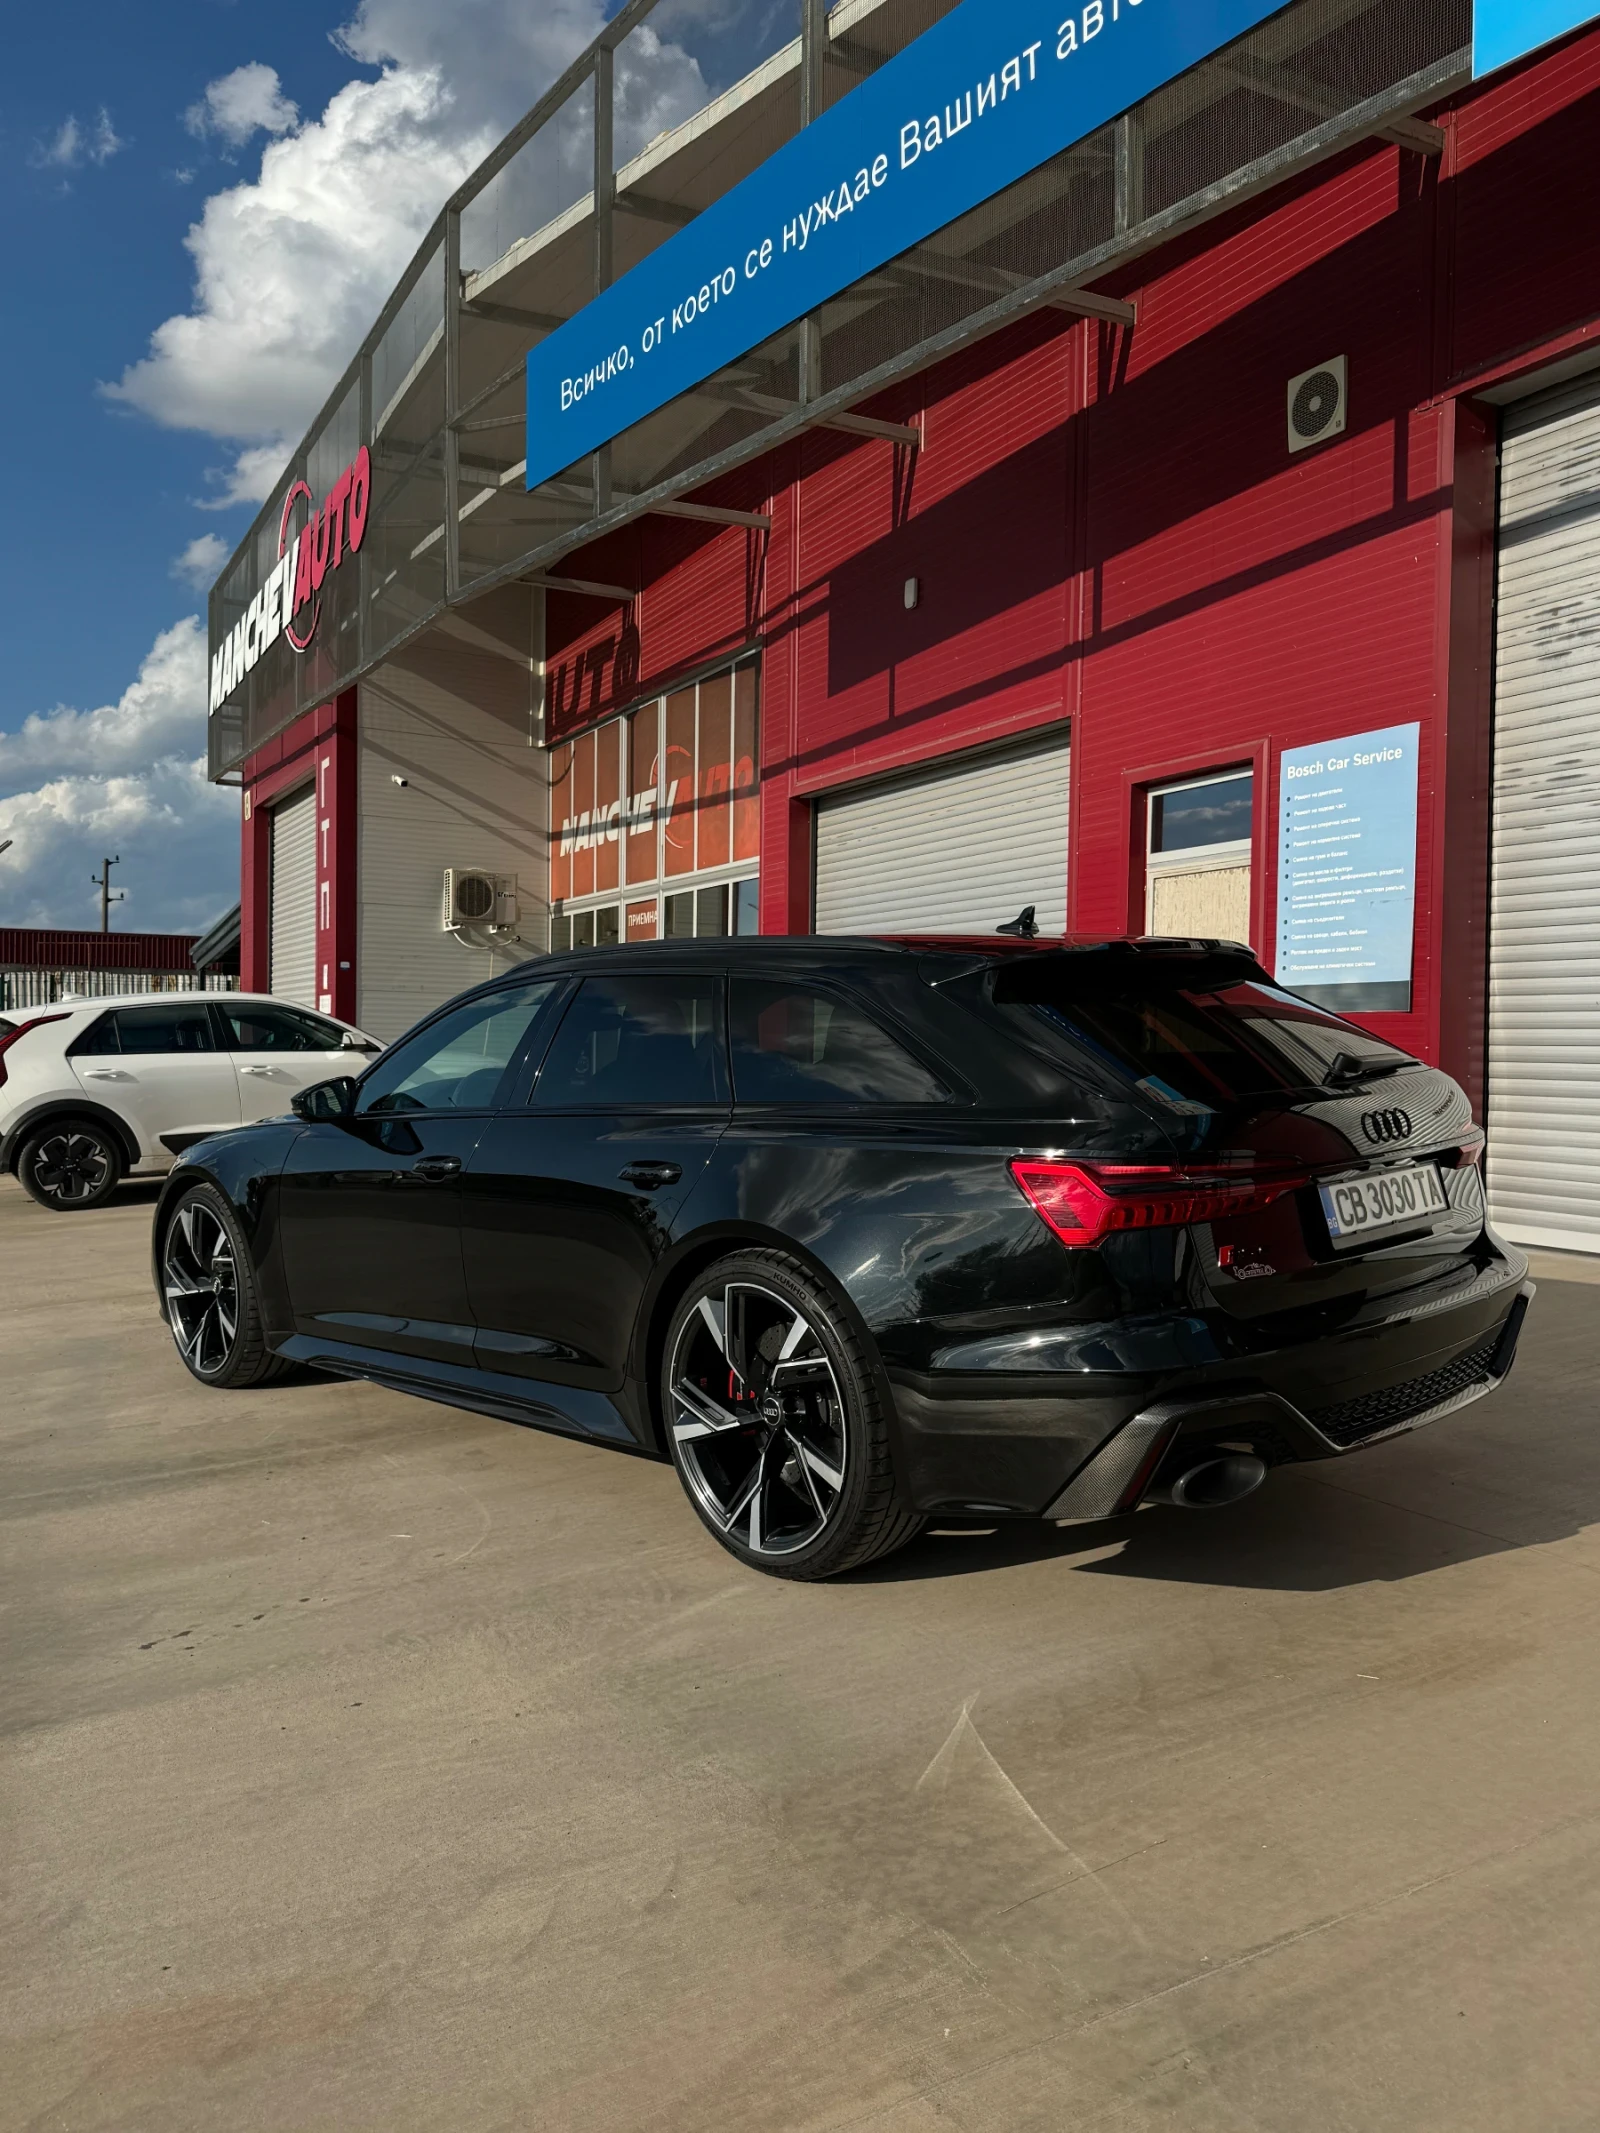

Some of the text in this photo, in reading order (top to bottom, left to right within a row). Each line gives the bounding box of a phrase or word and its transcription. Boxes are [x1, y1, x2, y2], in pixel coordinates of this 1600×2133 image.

[561, 345, 635, 411] Всичко,
[642, 317, 665, 353] от
[672, 266, 736, 334] което
[745, 238, 773, 279] се
[783, 153, 888, 252] нуждае
[900, 40, 1042, 170] Вашият
[1287, 747, 1403, 780] Bosch Car Service
[1335, 1169, 1442, 1227] CB 3030 TA
[1327, 1217, 1337, 1229] BG
[773, 1272, 807, 1301] KUMHO
